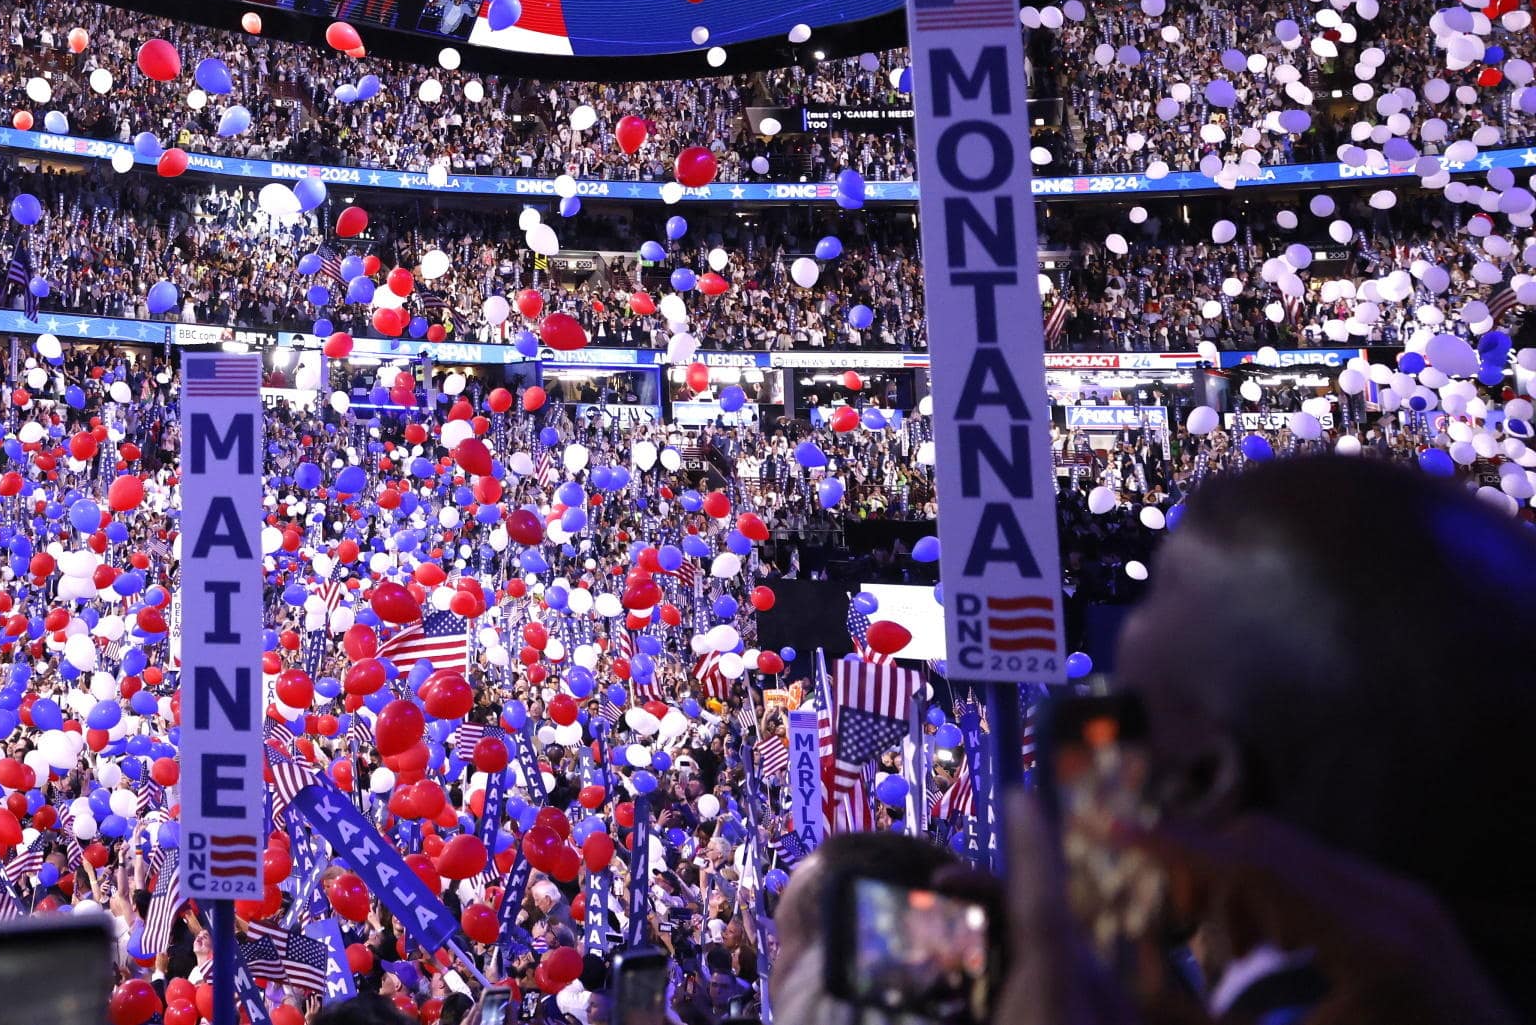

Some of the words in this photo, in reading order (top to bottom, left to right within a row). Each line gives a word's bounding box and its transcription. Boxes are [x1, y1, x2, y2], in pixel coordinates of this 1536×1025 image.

[843, 110, 880, 119] 'CAUSE
[888, 110, 915, 119] NEED
[808, 120, 828, 129] TOO
[39, 133, 76, 153] DNC
[188, 156, 224, 170] AMALA
[271, 162, 311, 179] DNC
[320, 167, 361, 183] 2024
[575, 182, 610, 196] 024
[776, 186, 817, 199] DNC
[1089, 177, 1140, 193] 2024
[928, 45, 1043, 579] MONTANA
[178, 329, 217, 342] BBC.com
[557, 350, 598, 363] NEWS
[707, 355, 757, 368] DECIDES
[1045, 356, 1116, 368] EMOCRACY
[606, 407, 655, 424] NEWS
[1245, 415, 1282, 427] NBC
[687, 461, 701, 470] 104
[172, 602, 181, 638] DELAW
[190, 412, 255, 820] MAINE
[955, 592, 984, 671] DNC
[990, 655, 1058, 673] 2024
[515, 732, 544, 798] KAMALA
[795, 733, 817, 846] MARYLA
[187, 832, 207, 892] DNC
[210, 879, 257, 894] 2024
[315, 794, 439, 931] KAMALA
